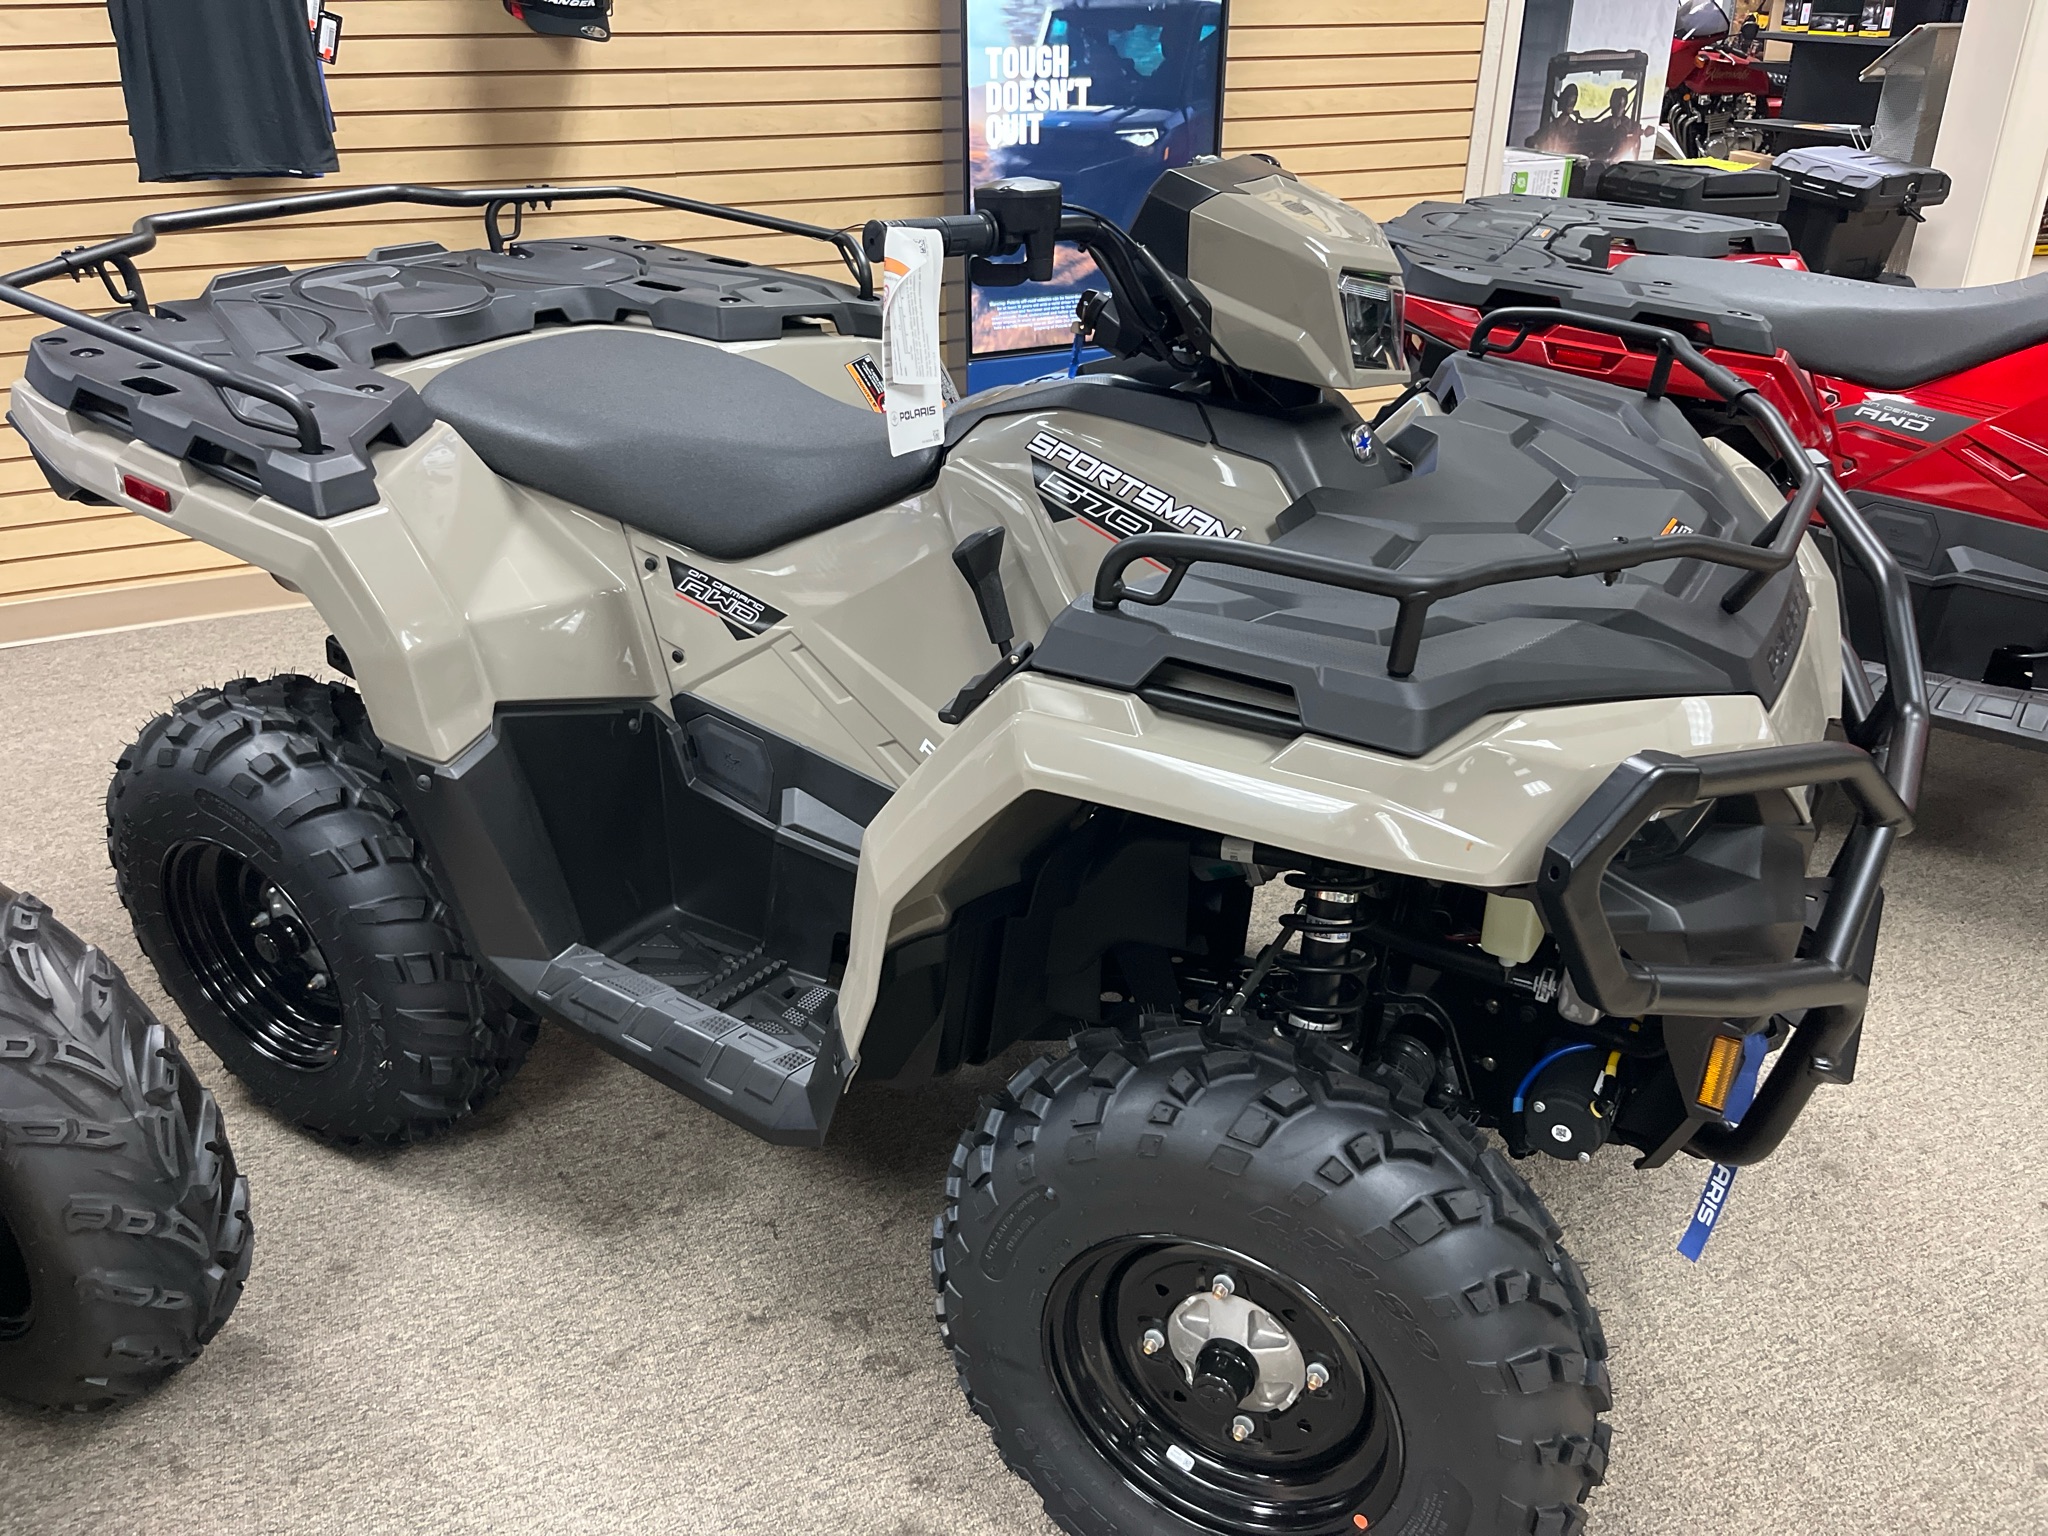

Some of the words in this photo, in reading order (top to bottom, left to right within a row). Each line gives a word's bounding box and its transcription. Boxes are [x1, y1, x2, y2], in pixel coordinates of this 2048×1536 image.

[984, 44, 1070, 80] TOUGH
[984, 77, 1092, 113] DOESN'T
[984, 113, 1045, 150] QUIT
[899, 405, 937, 422] POLARIS
[1854, 406, 1930, 433] AWD
[1861, 399, 1881, 408] ON
[1883, 405, 1936, 423] DEMAND
[1025, 431, 1243, 540] SPORTSMAN
[1039, 470, 1153, 537] 570
[677, 576, 760, 625] AWD
[688, 569, 709, 583] ON
[711, 580, 765, 612] DEMAND
